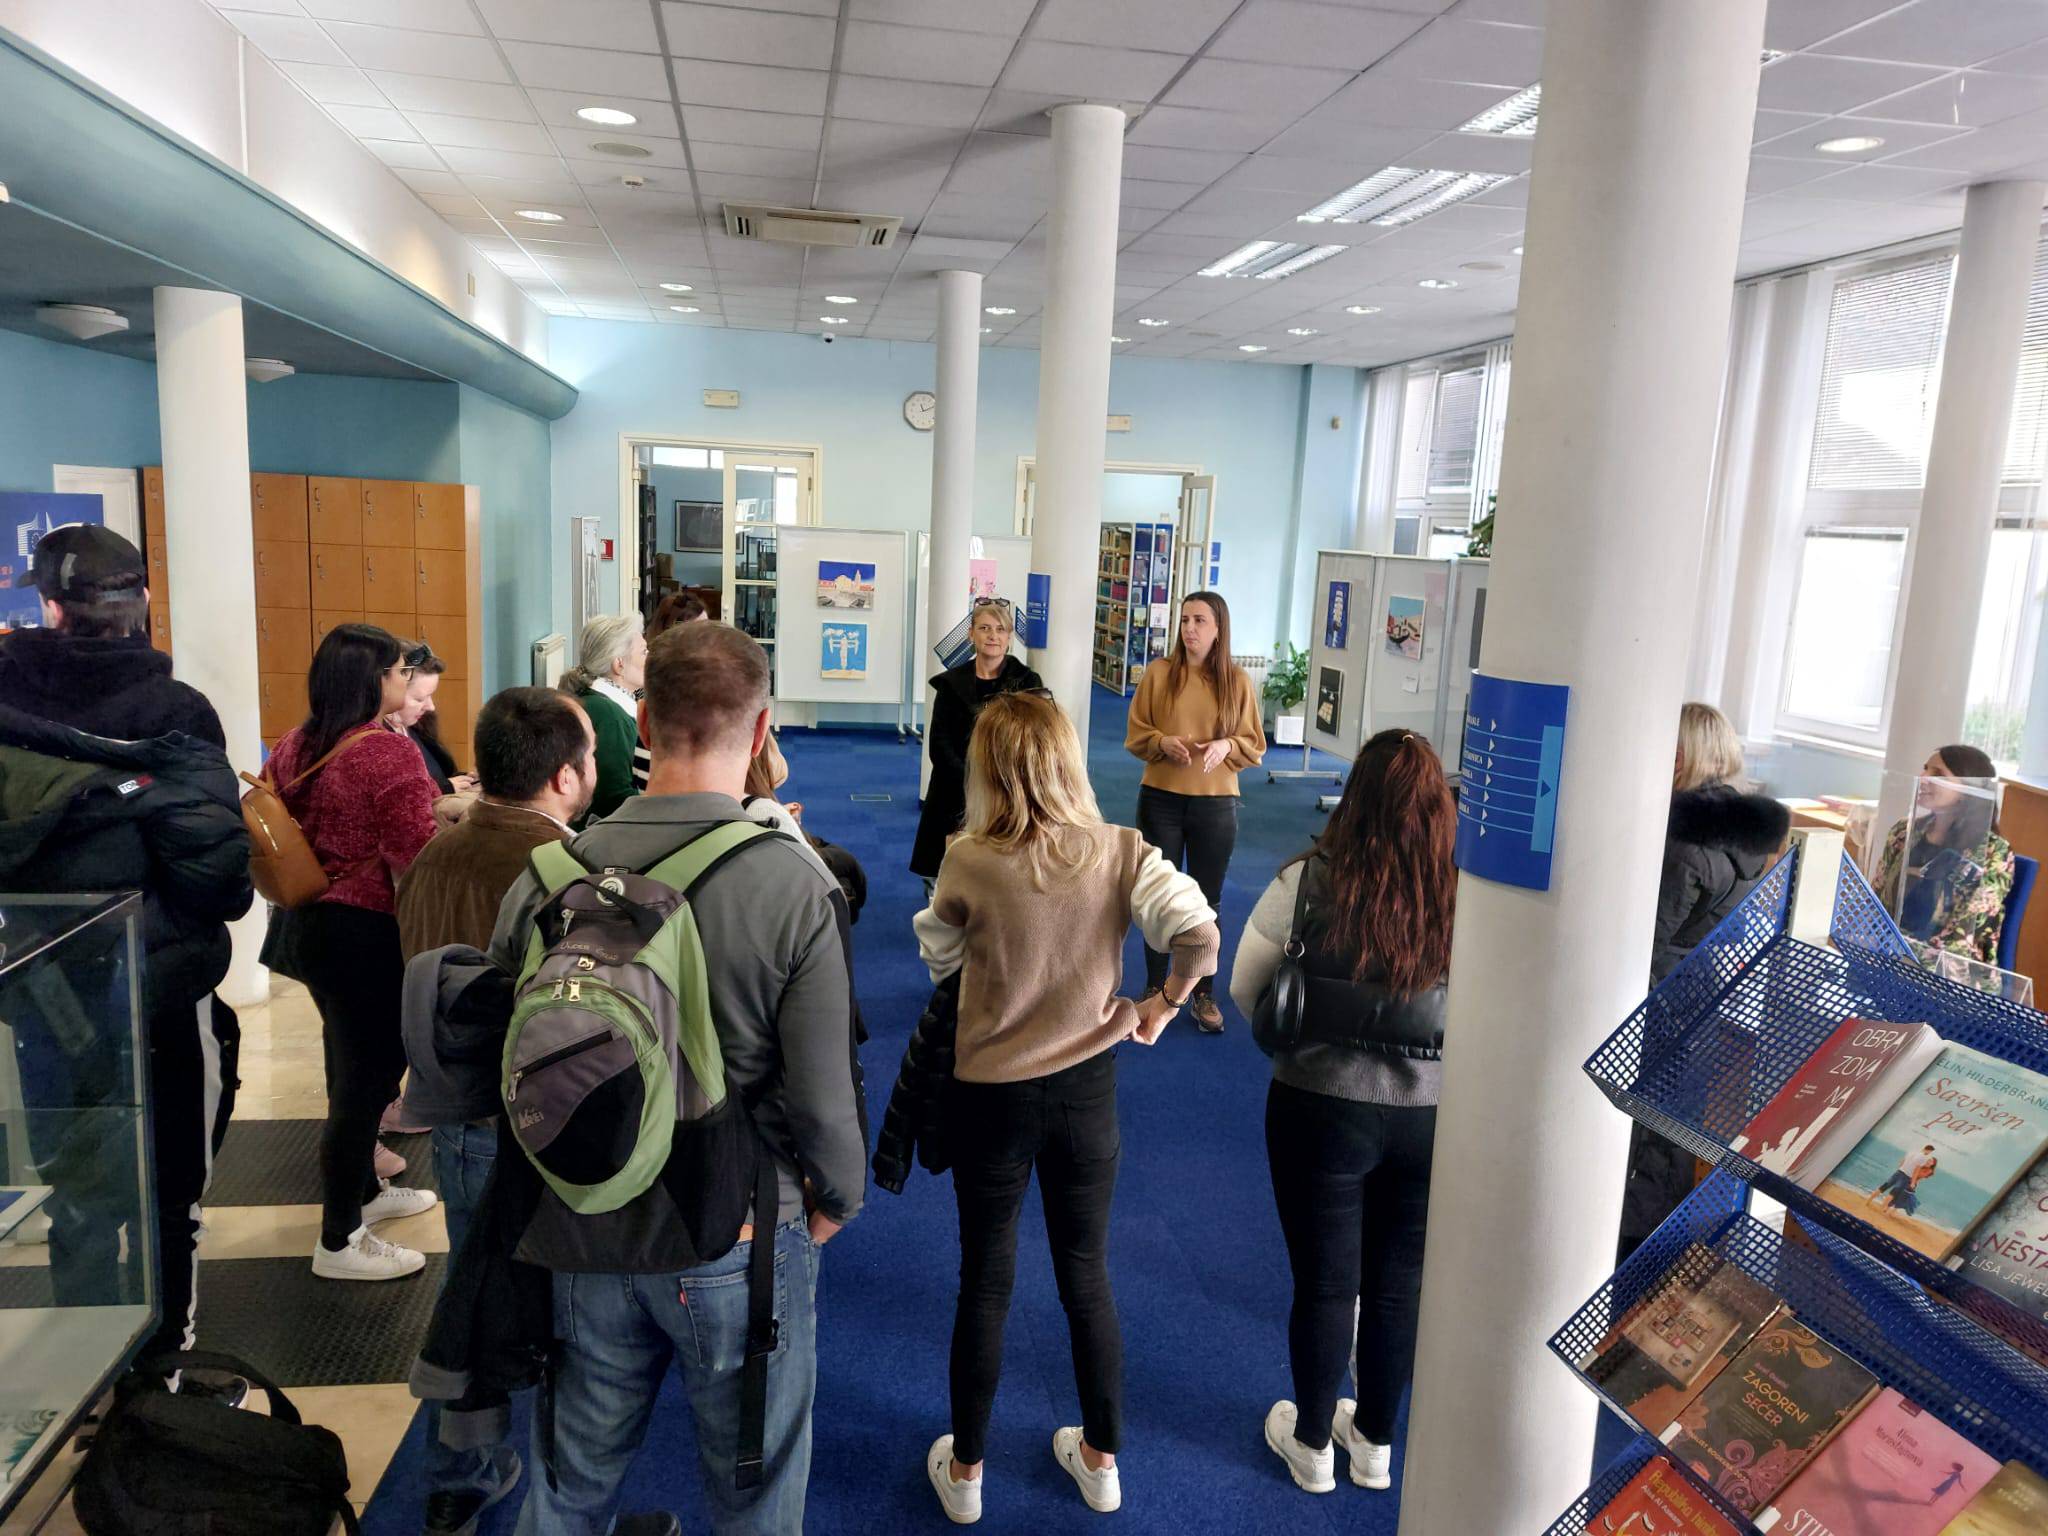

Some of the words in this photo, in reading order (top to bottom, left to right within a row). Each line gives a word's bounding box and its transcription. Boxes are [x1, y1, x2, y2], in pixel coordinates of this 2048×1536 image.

[1852, 1028, 1908, 1054] OBRA
[1829, 1055, 1882, 1081] ZOVA
[1936, 1057, 1964, 1075] ELIN
[1823, 1085, 1856, 1108] NA
[1926, 1077, 2025, 1130] Savršen
[1922, 1110, 1982, 1135] par
[1970, 1256, 2000, 1275] LISA
[1742, 1370, 1809, 1423] ZAGORENI
